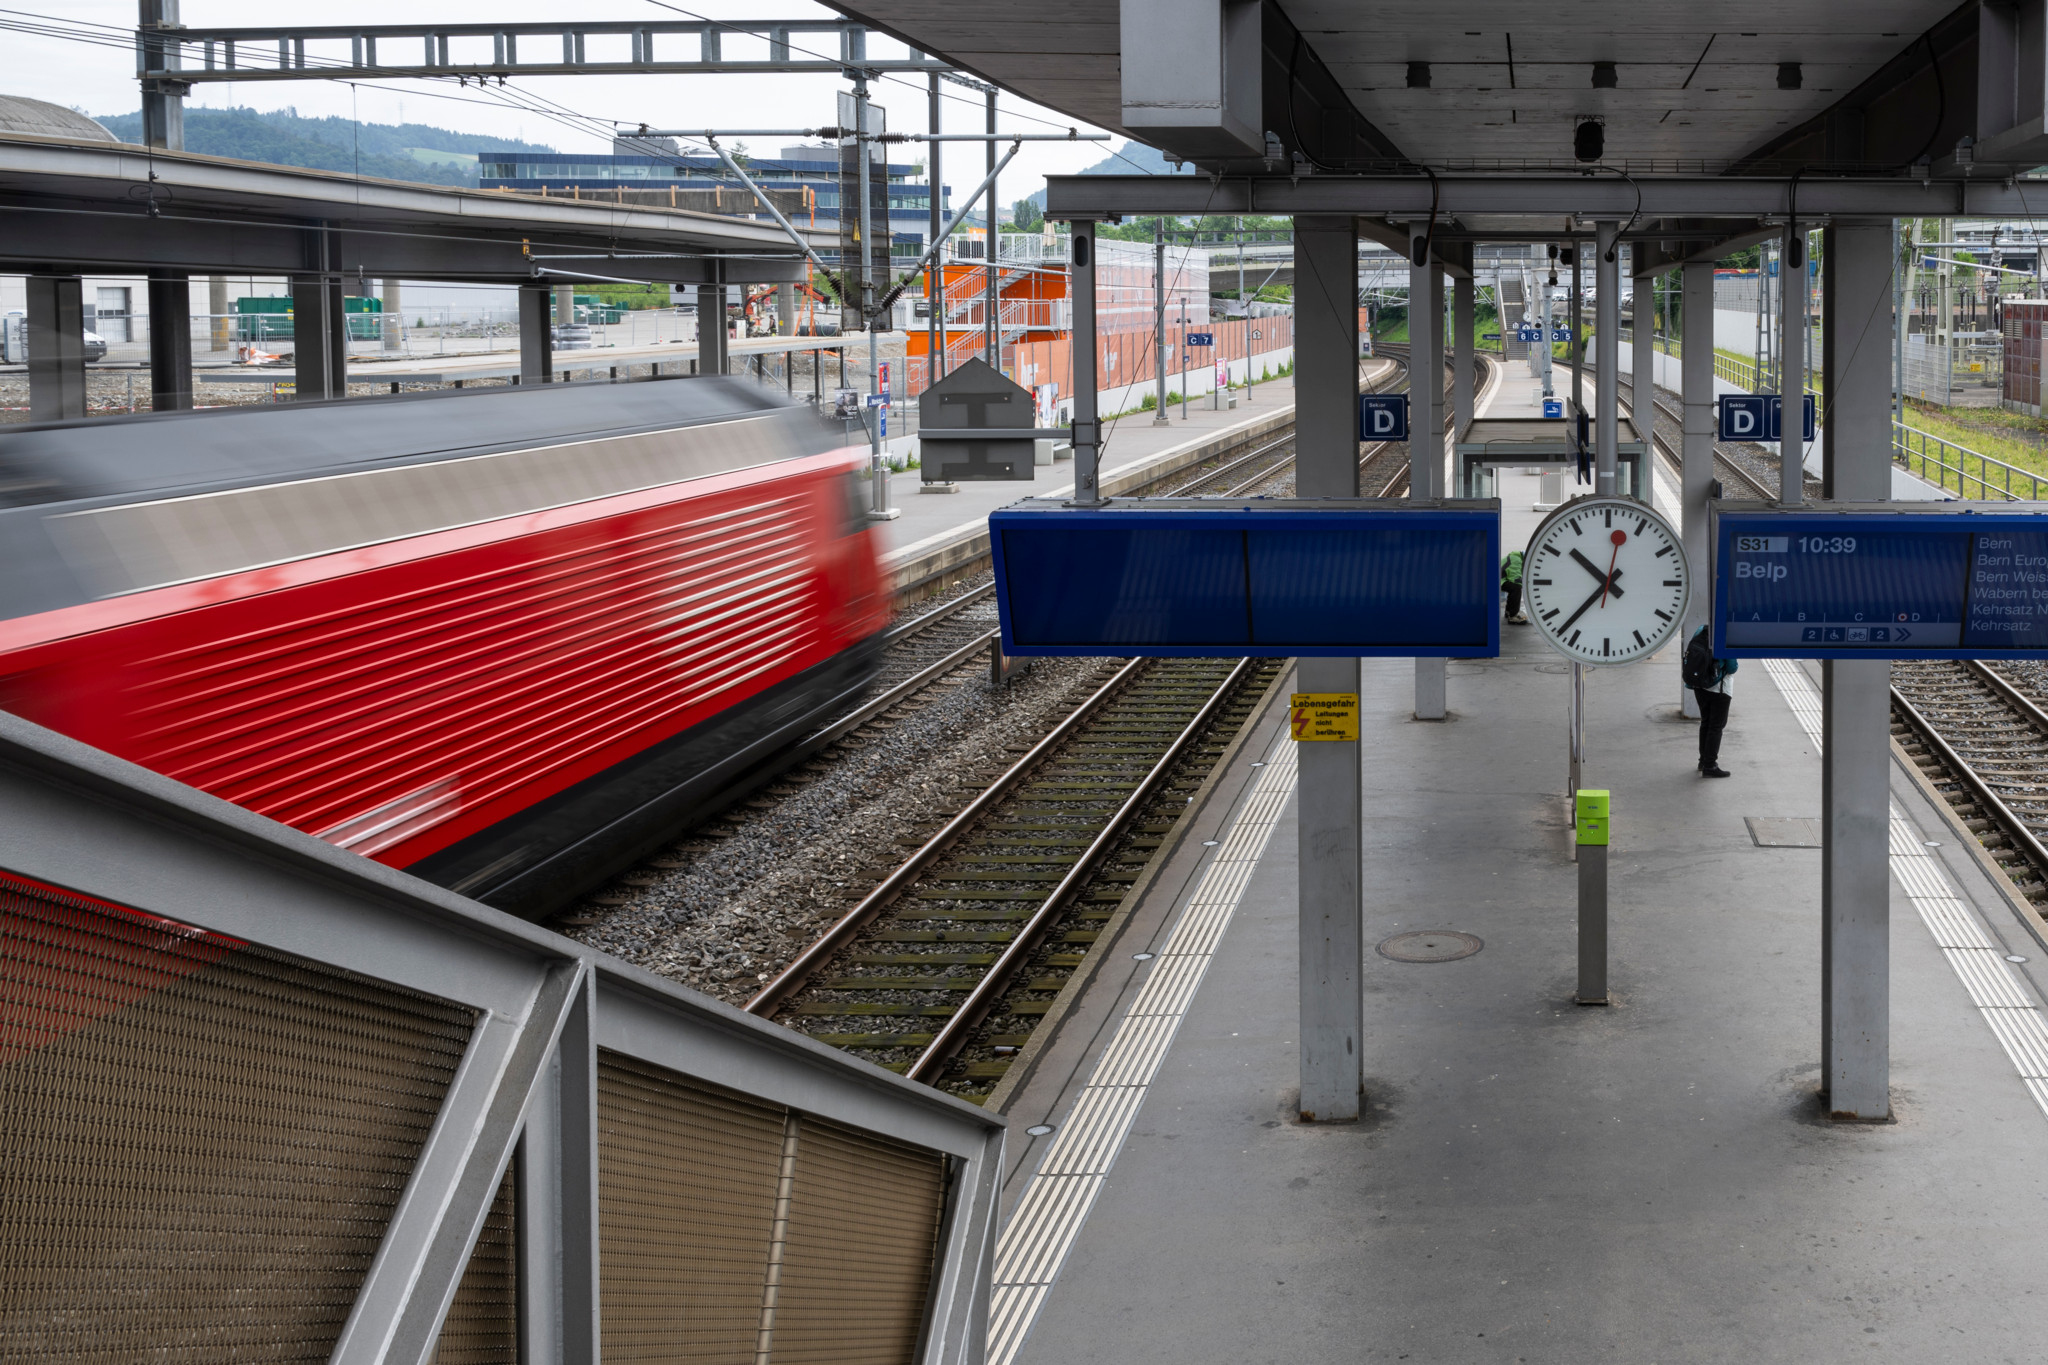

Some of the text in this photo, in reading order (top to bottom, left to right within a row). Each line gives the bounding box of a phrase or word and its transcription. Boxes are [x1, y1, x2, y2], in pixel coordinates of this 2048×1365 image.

[1374, 409, 1395, 433] D
[1733, 409, 1755, 433] D
[1740, 536, 1857, 553] S31 10:39
[1979, 537, 2012, 549] Bern
[1977, 554, 2048, 568] Bern Euro
[1735, 561, 1788, 582] Belp
[1976, 571, 2048, 583] Bern Weis
[1974, 587, 2048, 599] Wabern be
[1972, 603, 2048, 615] Kehrsatz N
[1752, 612, 1920, 621] A B C D
[1971, 620, 2032, 631] Kehrsatz
[1808, 630, 1884, 639] 2 2
[1293, 700, 1356, 708] Lebensgefahr
